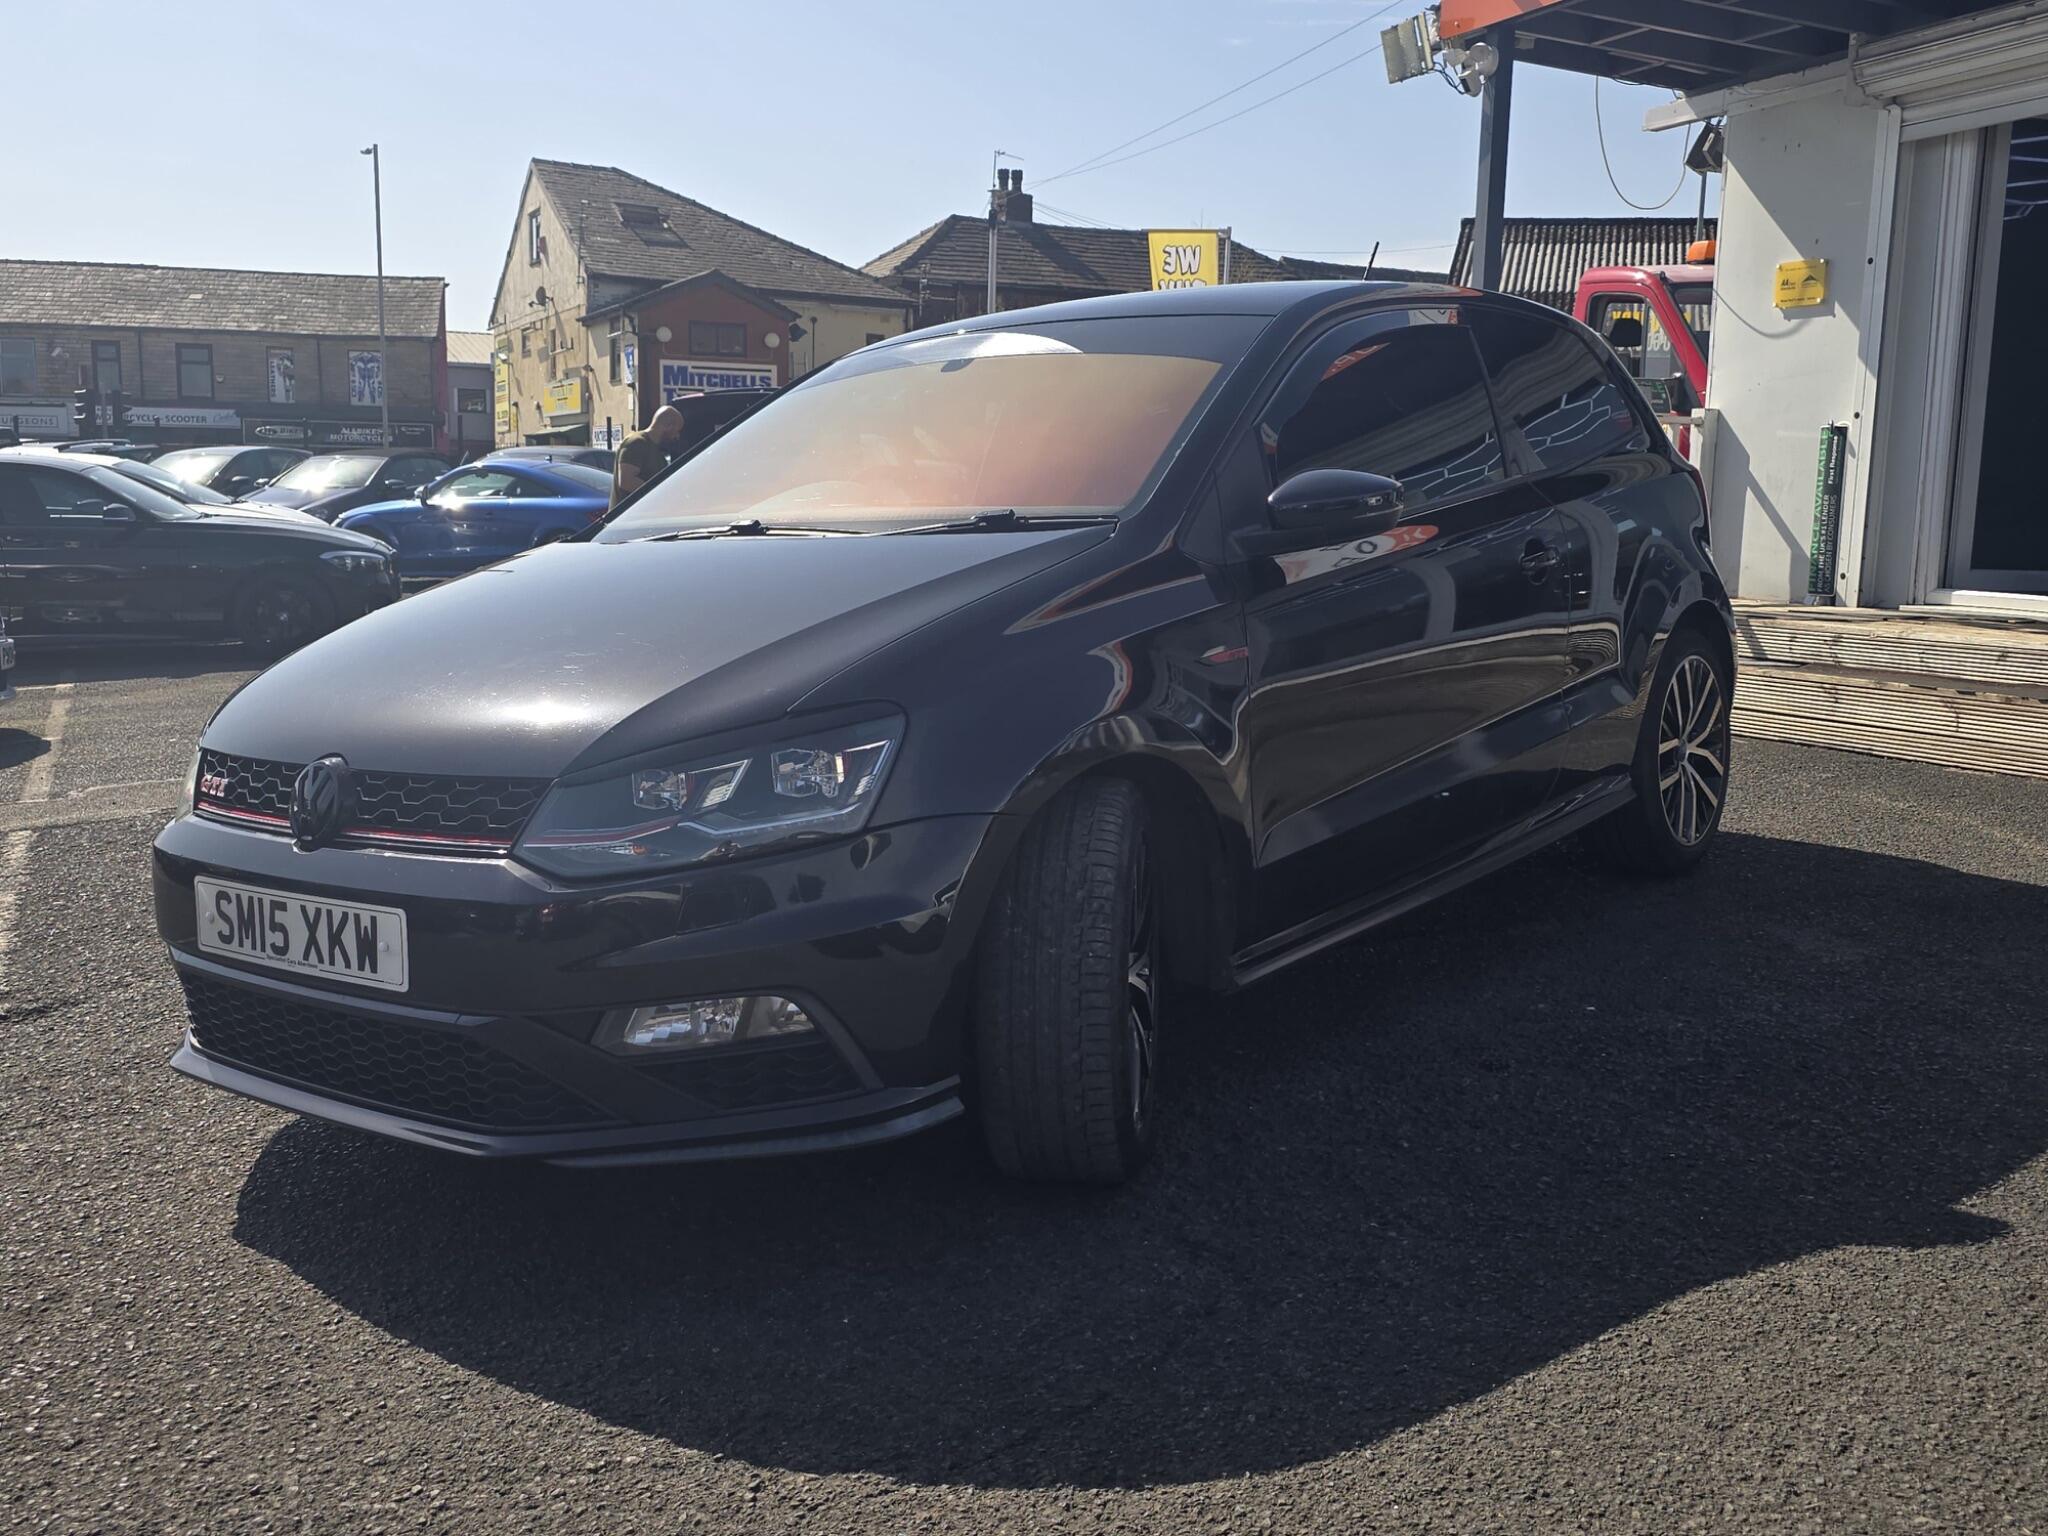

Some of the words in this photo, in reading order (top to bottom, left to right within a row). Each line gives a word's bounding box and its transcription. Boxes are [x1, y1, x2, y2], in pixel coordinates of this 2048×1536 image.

[663, 365, 772, 388] MITCHELLS
[165, 415, 207, 424] SCOOTER
[1830, 436, 1839, 468] Response
[1827, 469, 1835, 484] First
[1808, 521, 1820, 592] FINANCE
[1814, 428, 1829, 517] AVAILABLE
[1821, 495, 1830, 524] LENDER
[1826, 495, 1837, 541] CONSUMERS
[1826, 541, 1833, 551] BY
[1817, 554, 1825, 568] THE
[1823, 551, 1834, 581] CHOSEN
[1816, 570, 1824, 592] FROM
[201, 775, 229, 797] GTI
[215, 890, 290, 957] SM15
[300, 904, 378, 974] XKW
